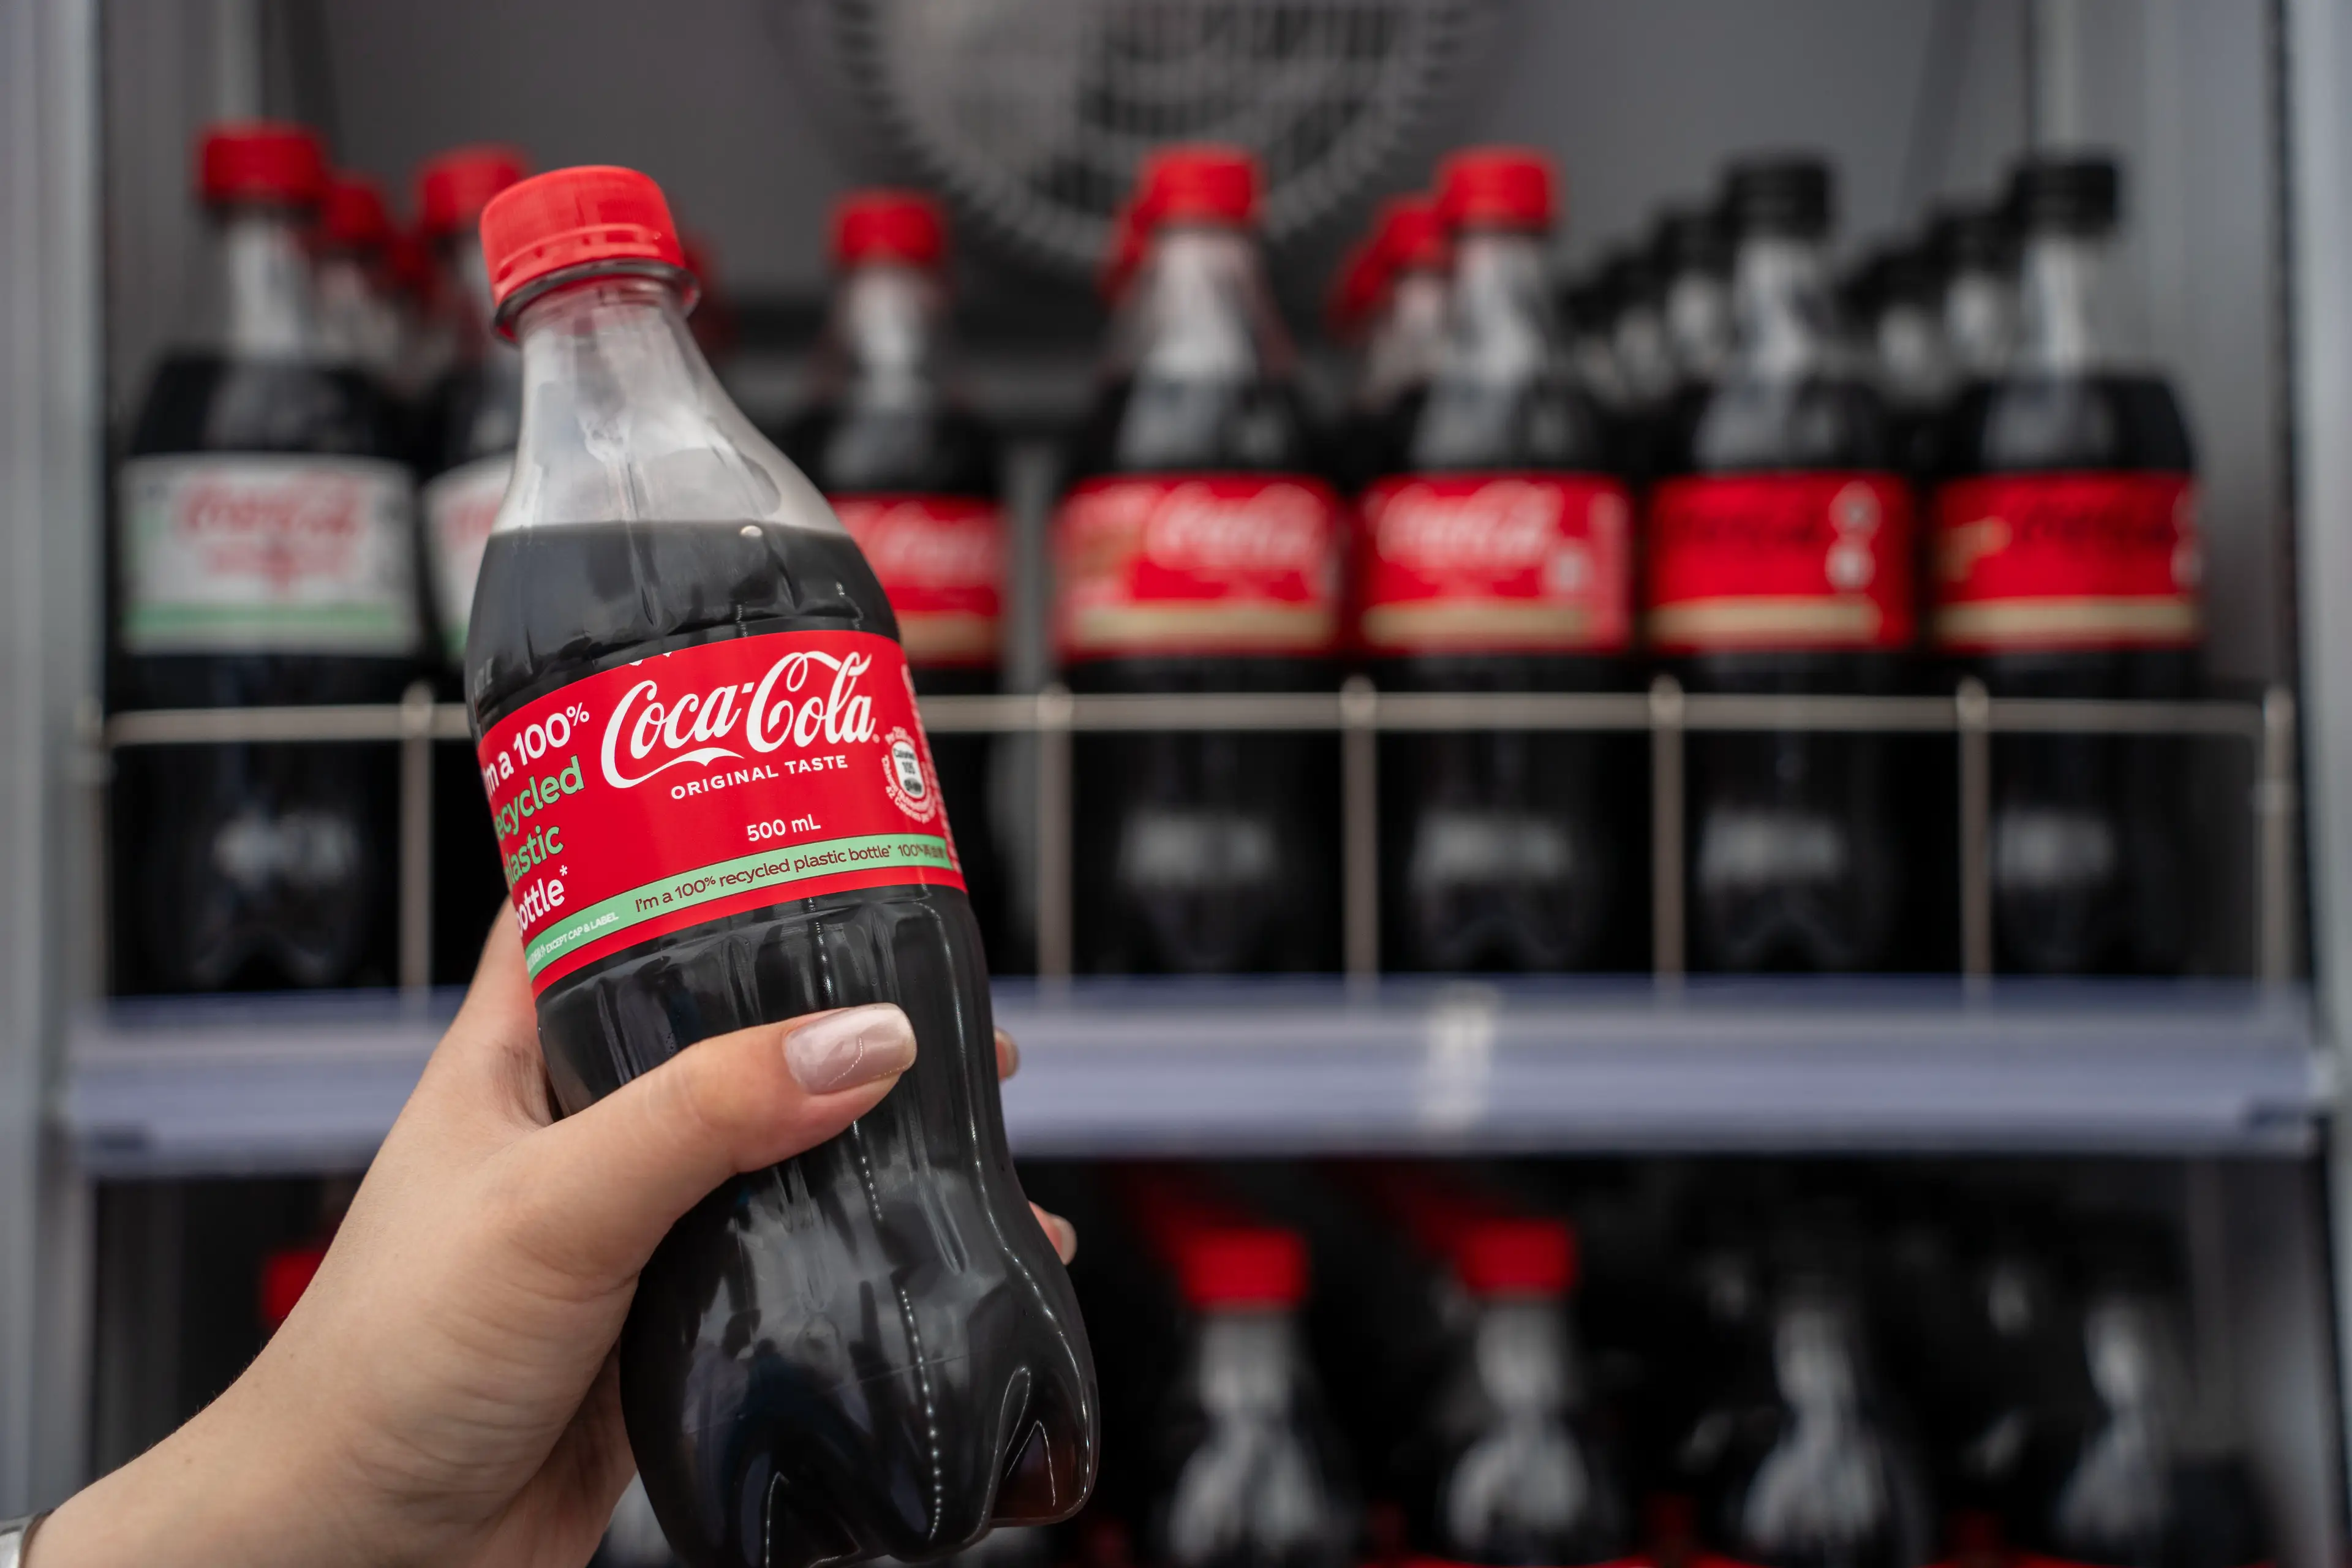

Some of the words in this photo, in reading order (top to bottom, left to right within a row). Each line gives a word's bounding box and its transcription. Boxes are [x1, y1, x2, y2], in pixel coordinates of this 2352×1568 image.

[498, 751, 514, 780] a
[513, 702, 590, 766] 100%
[601, 651, 876, 788] Coca-Cola
[494, 754, 585, 841] ecycled
[671, 765, 778, 800] ORIGINAL
[785, 755, 848, 774] TASTE
[747, 819, 786, 842] 500
[791, 814, 821, 834] mL
[635, 897, 659, 912] I'm
[662, 893, 673, 903] a
[674, 876, 716, 899] 100%
[720, 859, 791, 888] recycled
[794, 850, 847, 873] plastic
[546, 934, 568, 954] EXCEPT
[568, 926, 583, 940] CAP
[583, 923, 591, 933] &
[590, 912, 619, 930] LABEL
